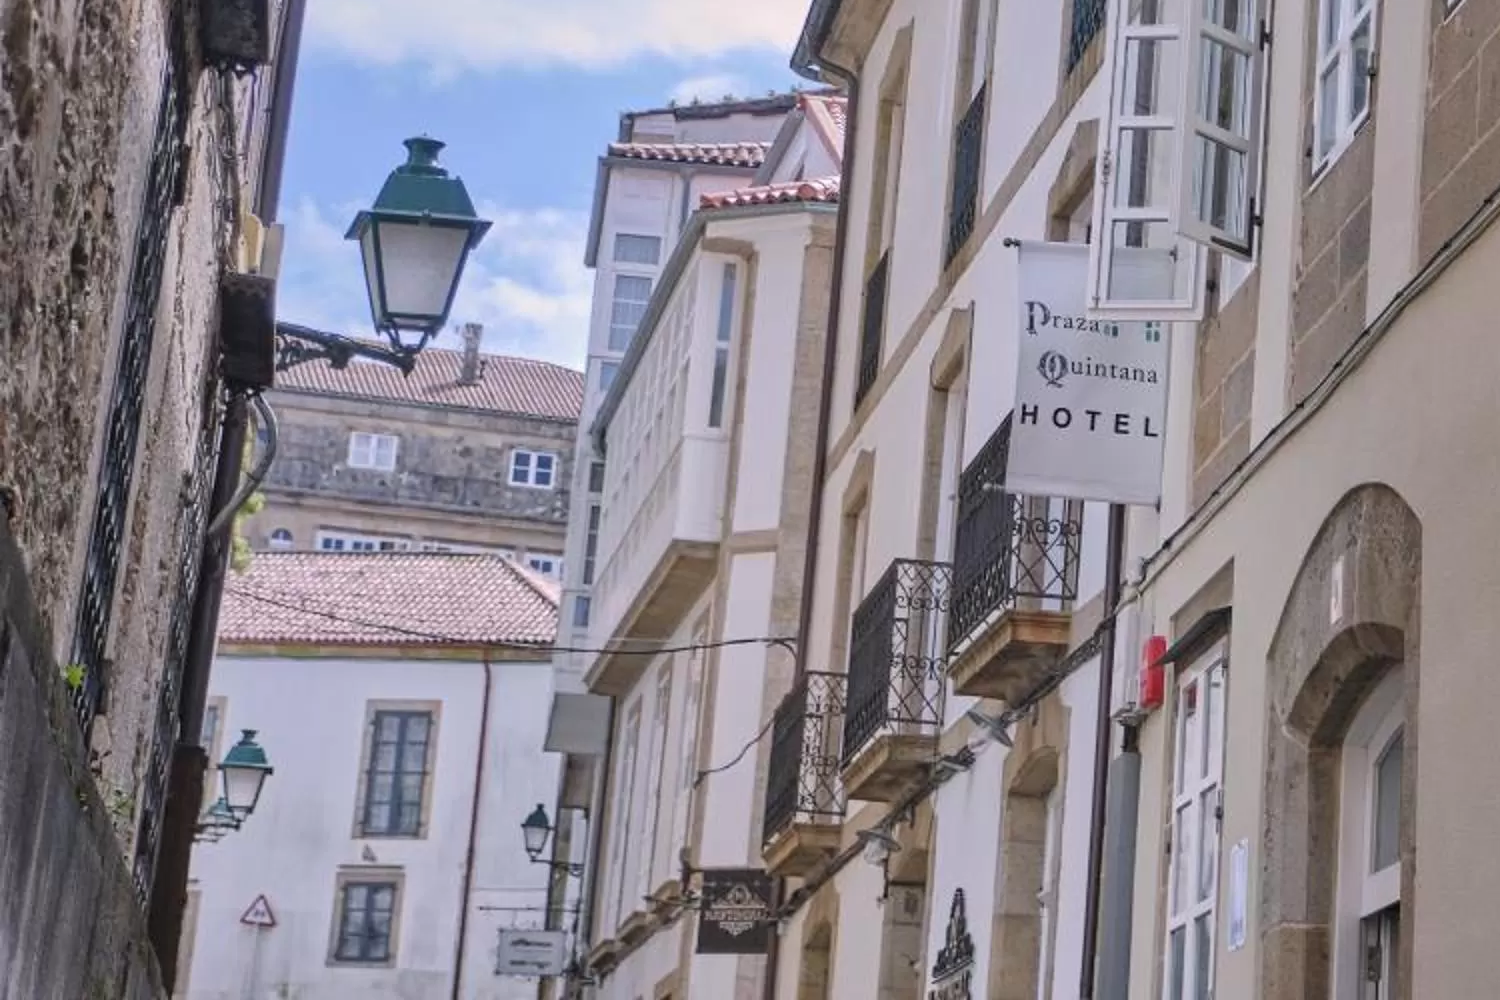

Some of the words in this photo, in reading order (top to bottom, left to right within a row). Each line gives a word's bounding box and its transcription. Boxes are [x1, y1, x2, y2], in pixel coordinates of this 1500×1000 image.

[1024, 300, 1101, 336] Praza
[1036, 350, 1158, 388] Quintana
[1020, 402, 1159, 438] HOTEL
